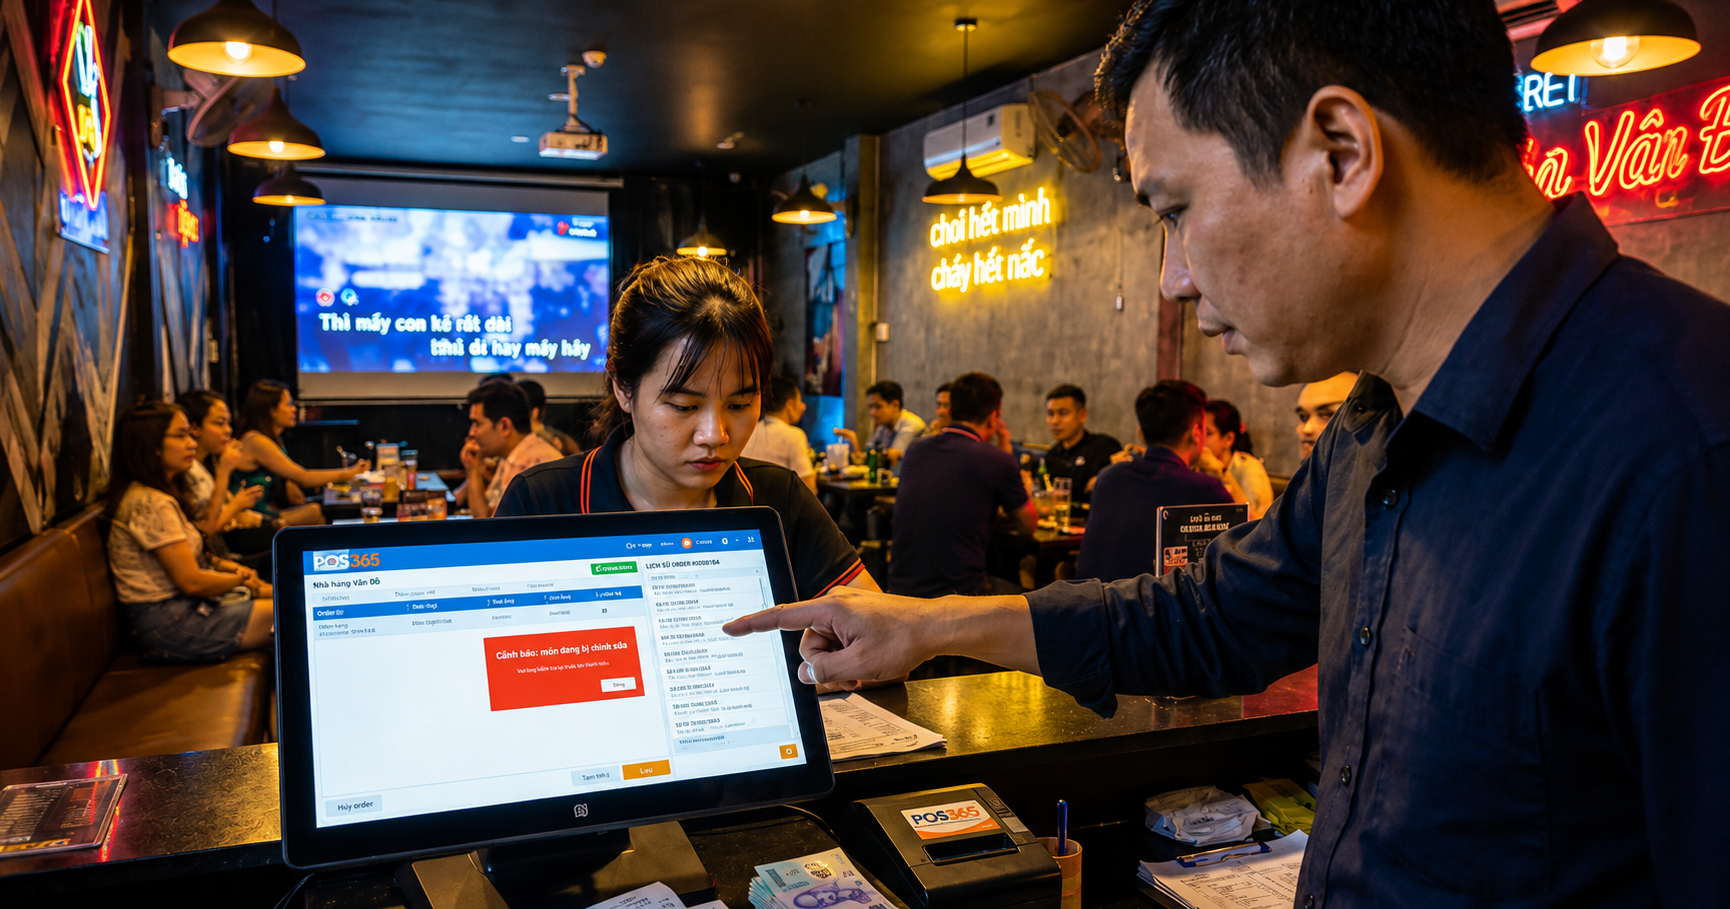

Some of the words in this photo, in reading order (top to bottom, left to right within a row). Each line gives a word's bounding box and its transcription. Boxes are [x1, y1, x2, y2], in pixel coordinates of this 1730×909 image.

[1585, 108, 1688, 196] Vân
[395, 317, 427, 332] con
[354, 801, 374, 809] order
[911, 805, 980, 825] POS365
